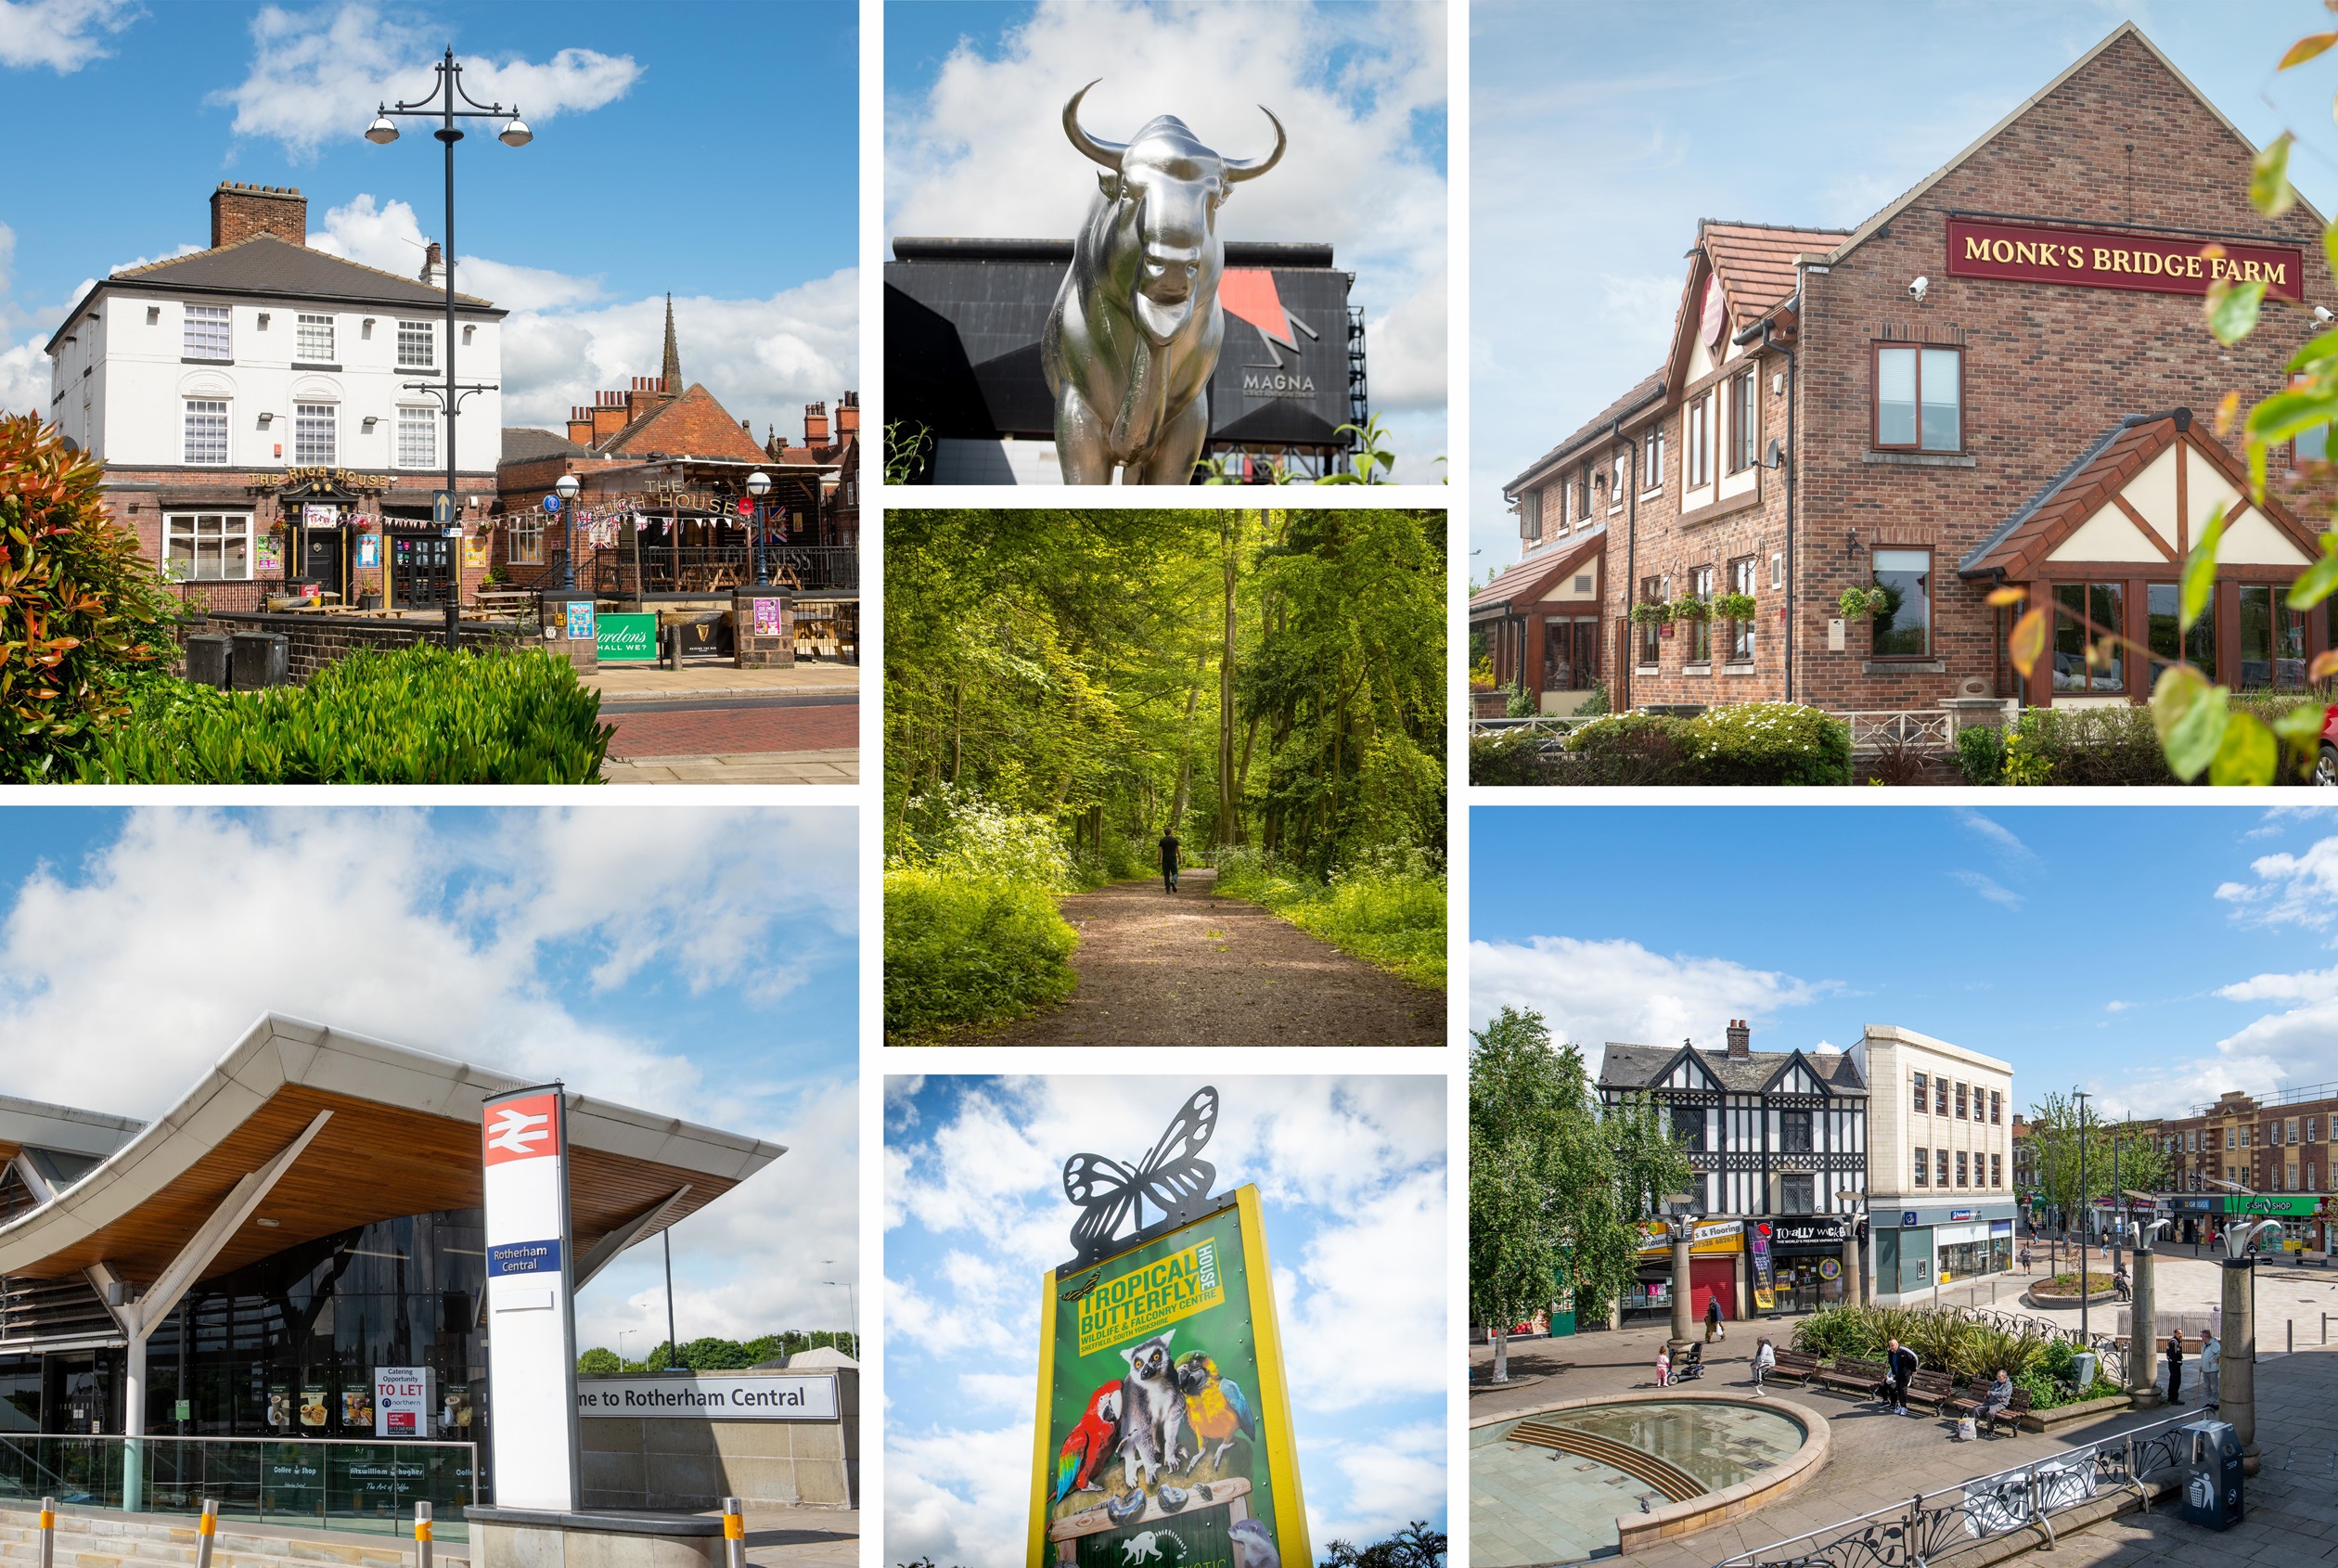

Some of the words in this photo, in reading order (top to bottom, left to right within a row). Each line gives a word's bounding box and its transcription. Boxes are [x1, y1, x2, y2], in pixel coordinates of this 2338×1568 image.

[1964, 237, 2085, 269] MONK'S
[2092, 248, 2203, 278] BRIDGE
[2210, 258, 2286, 285] FARM
[1243, 374, 1316, 391] MAGNA
[249, 473, 278, 485] THE
[288, 466, 327, 481] HIGH
[335, 469, 386, 486] HOUSE
[644, 480, 683, 493] THE
[591, 494, 646, 520] HIGH
[660, 493, 737, 517] HOUSE
[2272, 1202, 2291, 1210] SHOP
[1709, 1225, 1741, 1236] Flooring
[494, 1246, 547, 1261] Rotherham
[502, 1258, 537, 1272] Central
[1198, 1245, 1215, 1292] HOUSE
[1082, 1254, 1198, 1315] TROPICAL
[1081, 1274, 1198, 1335] BUTTERFLY
[1081, 1325, 1120, 1345] WILDLIFE
[1121, 1321, 1129, 1330] &
[1131, 1305, 1177, 1328] FALCONRY
[1179, 1289, 1216, 1310] CENTRE
[1113, 1330, 1134, 1341] SOUTH
[1135, 1317, 1169, 1333] YORKSHIRE
[378, 1384, 395, 1395] TO
[400, 1384, 423, 1395] LET
[601, 1392, 620, 1406] to
[624, 1388, 725, 1406] Rotherham
[731, 1387, 805, 1406] Central
[302, 1467, 316, 1475] Shop
[388, 1484, 393, 1492] of
